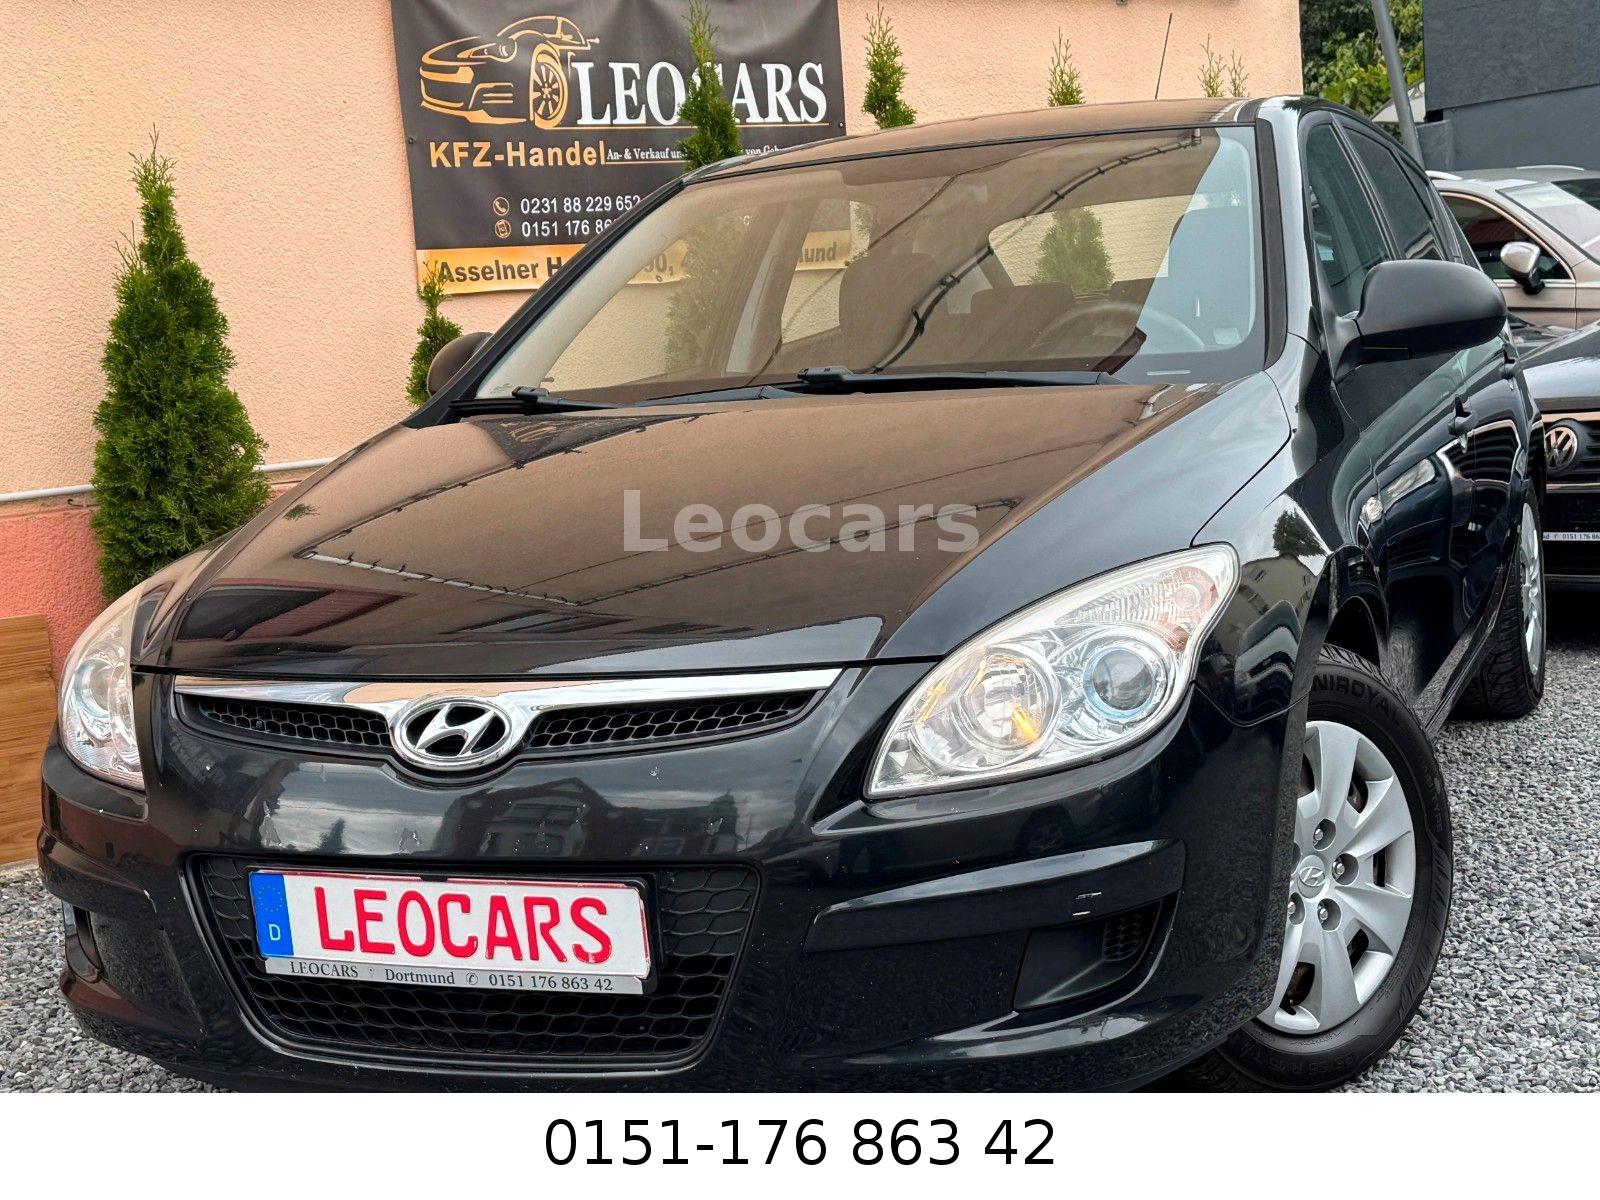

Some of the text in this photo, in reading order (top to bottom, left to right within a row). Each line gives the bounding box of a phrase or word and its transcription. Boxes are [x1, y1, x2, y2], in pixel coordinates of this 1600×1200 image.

[430, 140, 606, 169] KFZ-Handel
[634, 148, 668, 160] Verkauf
[520, 198, 558, 214] 0231
[563, 197, 582, 213] 88
[586, 196, 612, 212] 229
[521, 221, 558, 237] 0151
[565, 219, 590, 236] 176
[440, 256, 539, 284] Asselner
[268, 886, 613, 964] D LEOCARS
[290, 961, 614, 992] LEOCARS Dortmund 0151 176 863 42
